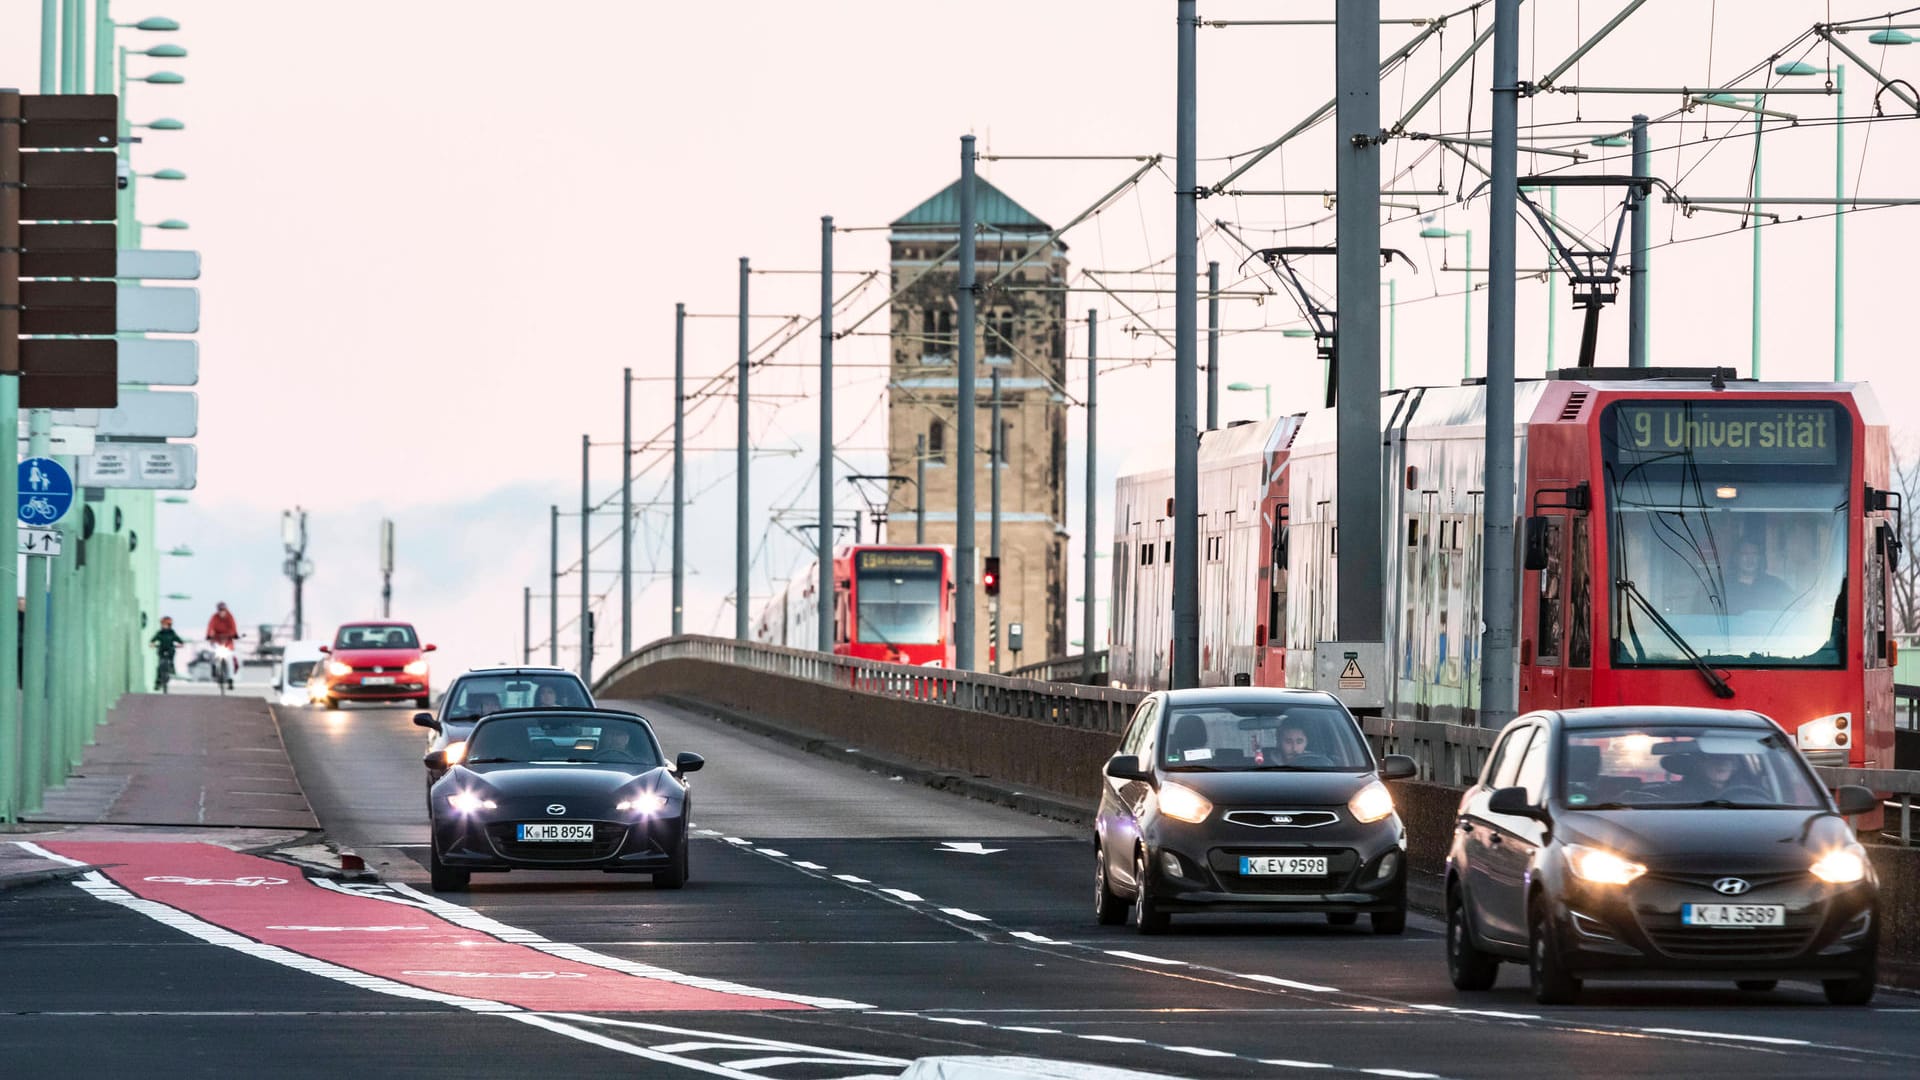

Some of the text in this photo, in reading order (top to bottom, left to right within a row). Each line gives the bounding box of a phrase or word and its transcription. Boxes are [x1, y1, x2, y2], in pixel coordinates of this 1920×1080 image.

[1635, 412, 1827, 448] 9 Universität
[525, 826, 592, 838] K HB 8954
[1249, 859, 1325, 873] K EY 9598
[1697, 907, 1776, 923] K A 3589
